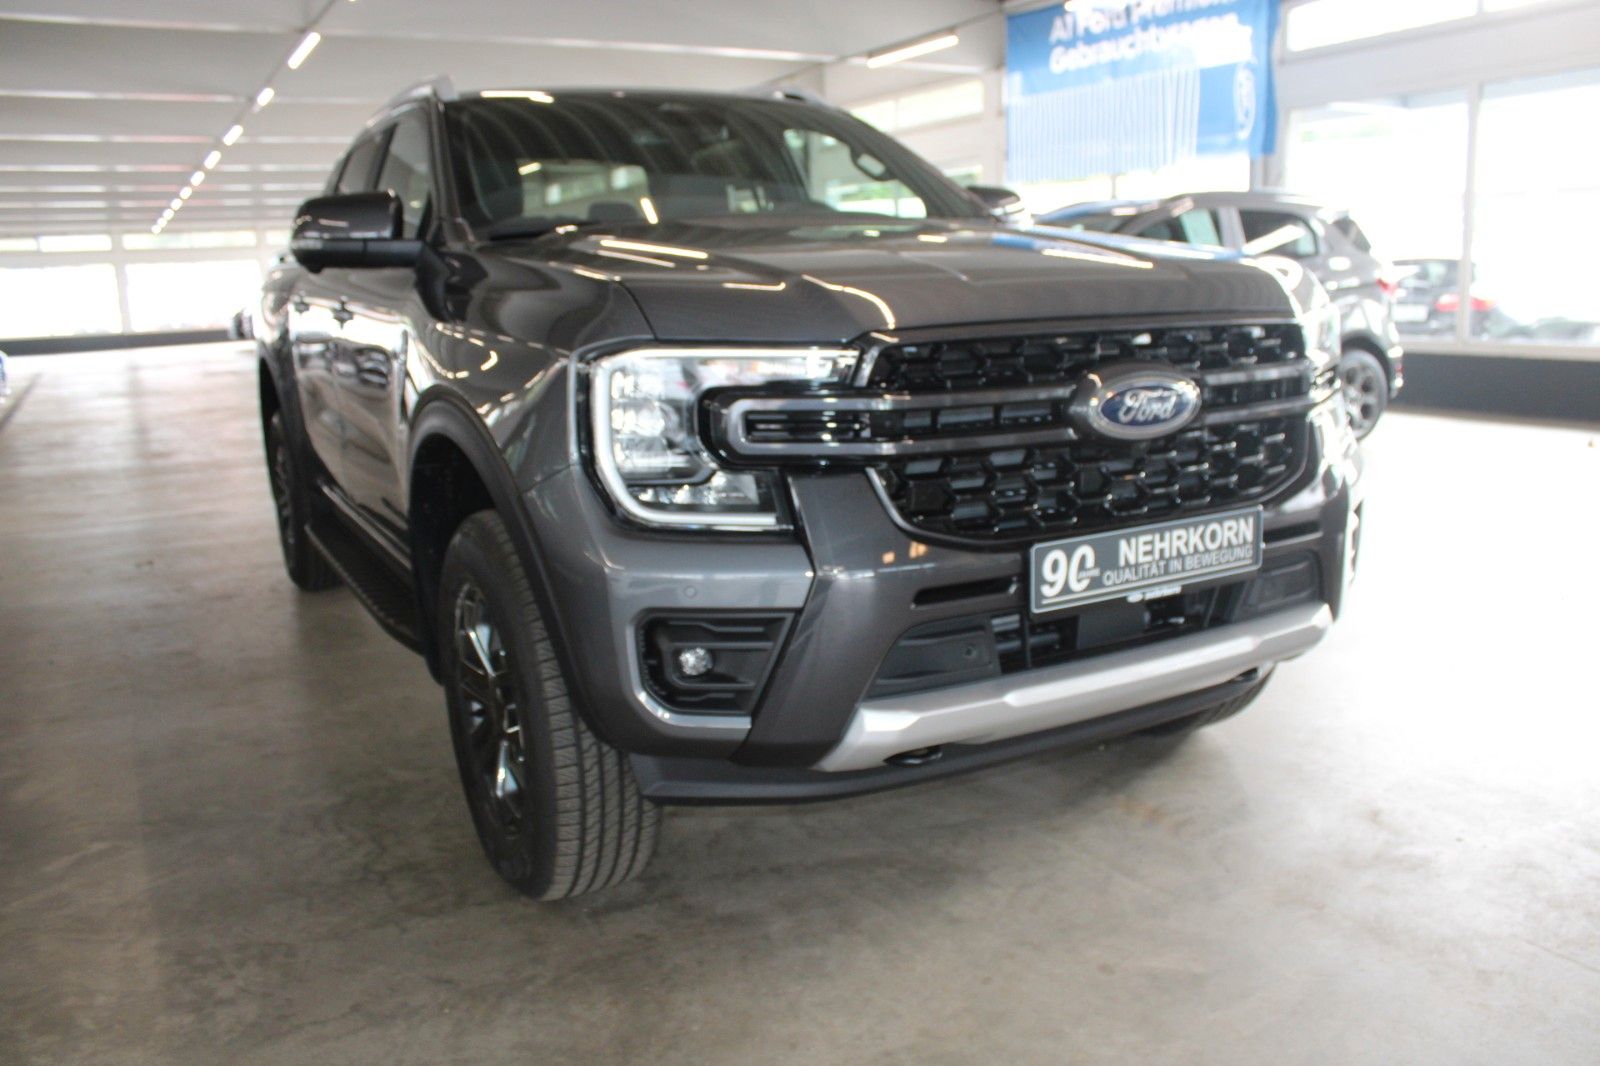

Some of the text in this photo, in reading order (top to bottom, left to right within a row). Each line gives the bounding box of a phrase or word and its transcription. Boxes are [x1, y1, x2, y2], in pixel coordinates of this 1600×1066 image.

[1118, 389, 1177, 424] Ford
[1118, 517, 1255, 567] NEHRKORN
[1168, 557, 1183, 572] IN
[1185, 545, 1254, 571] BEWEGUNG
[1040, 545, 1096, 597] 90
